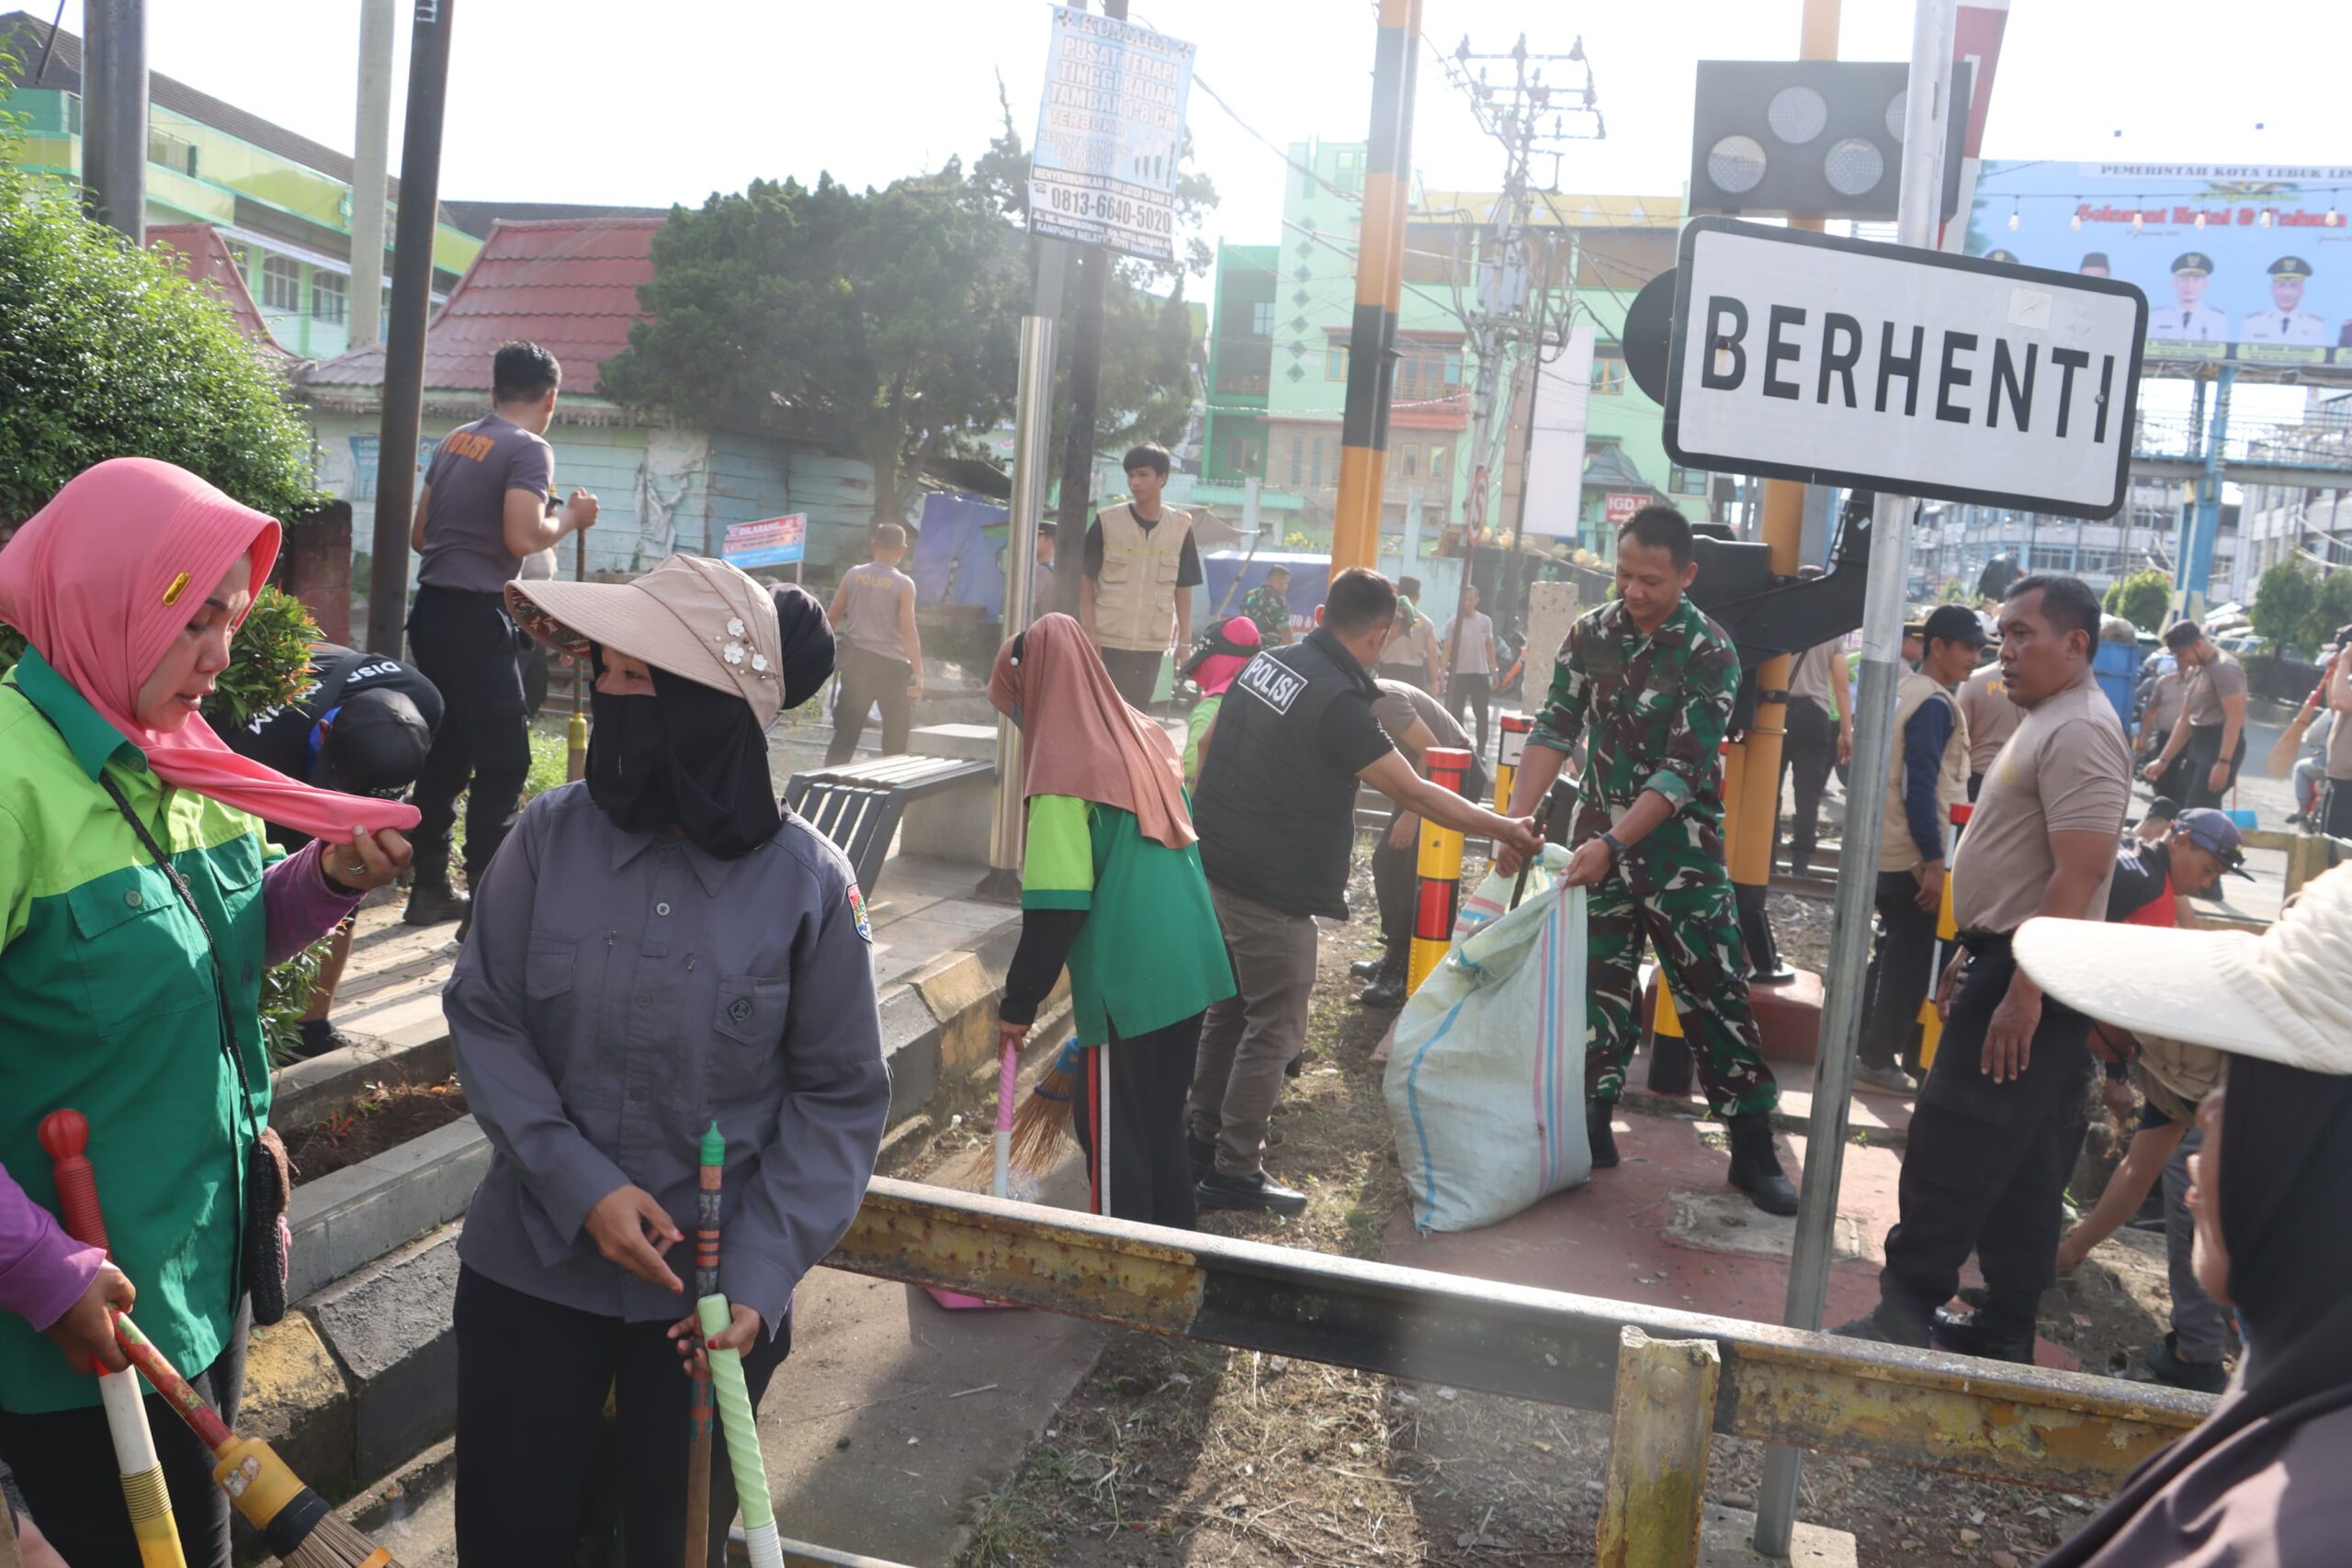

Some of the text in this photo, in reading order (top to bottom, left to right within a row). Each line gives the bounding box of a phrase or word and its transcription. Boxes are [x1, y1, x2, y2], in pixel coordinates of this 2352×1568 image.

[1079, 13, 1170, 55] KUMARA
[1058, 59, 1178, 107] TINGGI BADAN
[1062, 36, 1181, 84] PUSAT TERAPI
[1049, 82, 1181, 132] TAMBAH 1-8 CM
[1049, 107, 1125, 138] TERBUKTI
[2100, 164, 2208, 177] PEMERINTAH
[2214, 166, 2260, 179] KOTA
[1035, 221, 1076, 239] KAMPUNG
[1051, 186, 1171, 234] 0813-6640-5020
[1701, 294, 2116, 445] BERHENTI
[1609, 496, 1635, 511] IGD
[1244, 658, 1299, 706] POLISI
